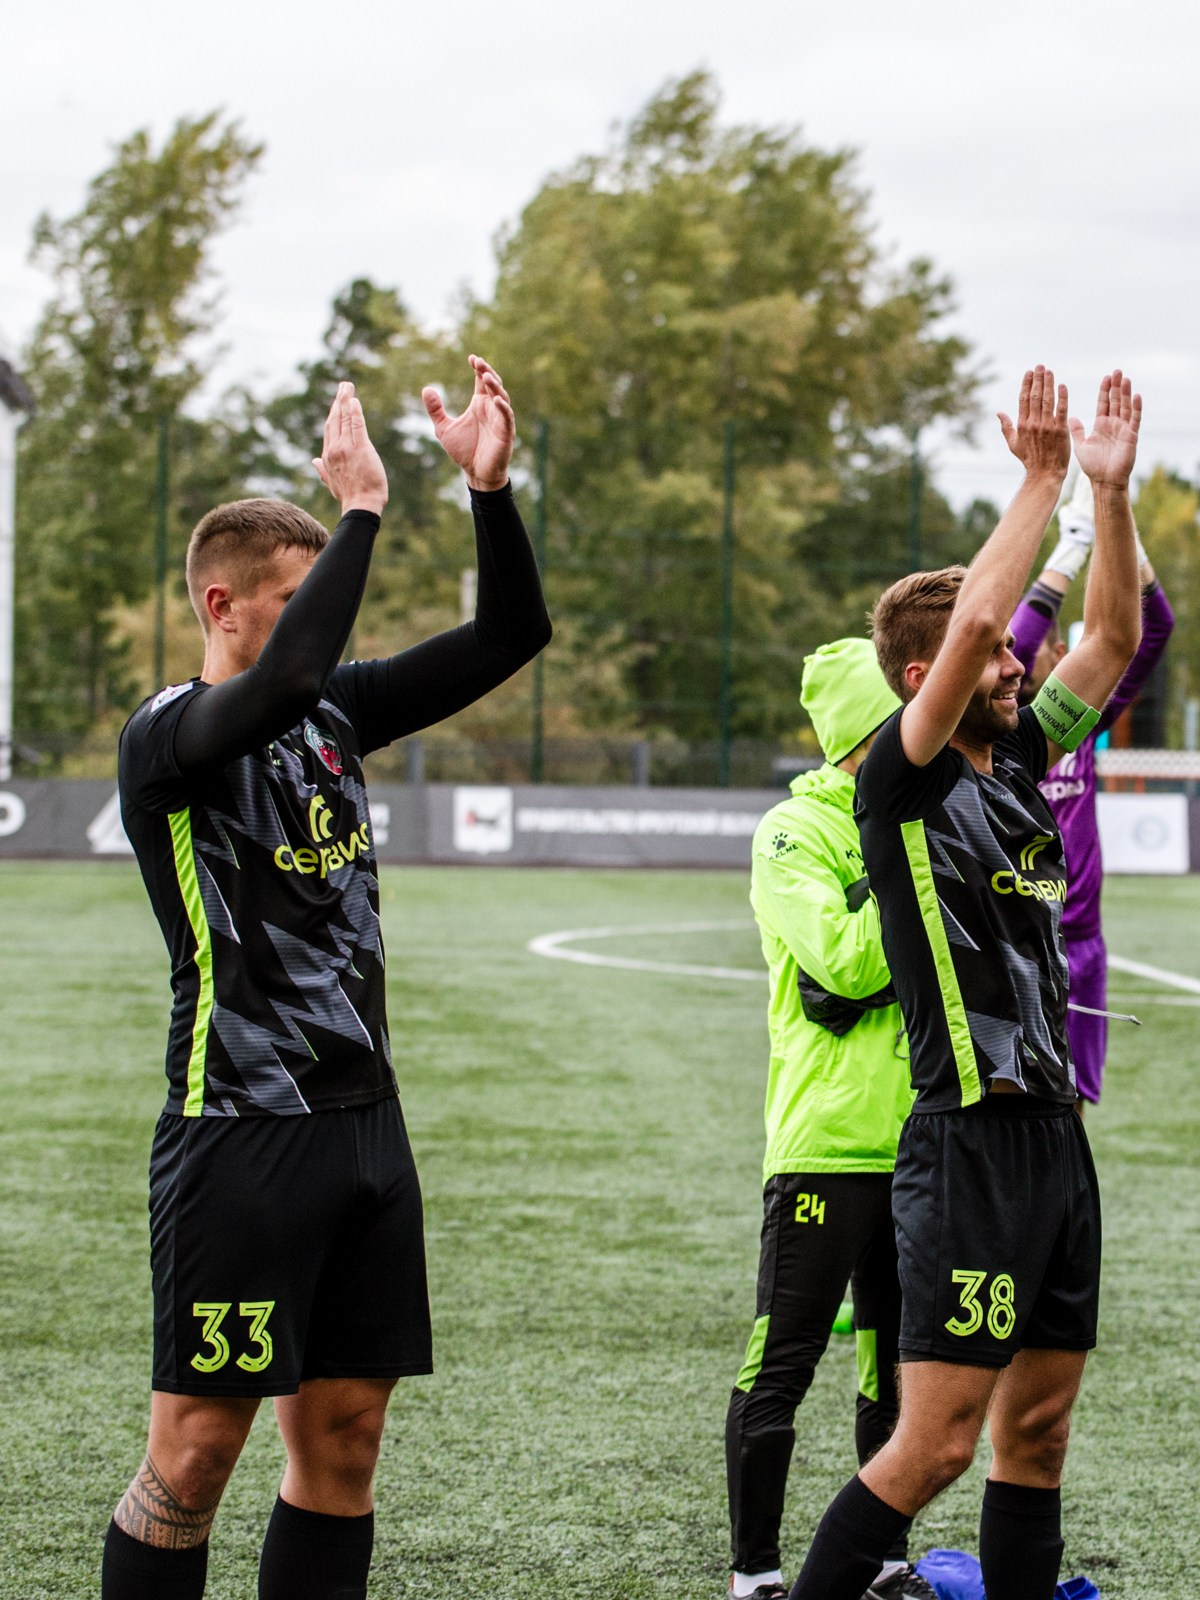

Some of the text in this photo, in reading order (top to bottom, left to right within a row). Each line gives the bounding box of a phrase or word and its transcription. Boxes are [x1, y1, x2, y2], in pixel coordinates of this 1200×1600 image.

[768, 843, 799, 861] KELME
[794, 1193, 826, 1224] 24
[944, 1269, 1016, 1340] 38
[190, 1301, 276, 1373] 33
